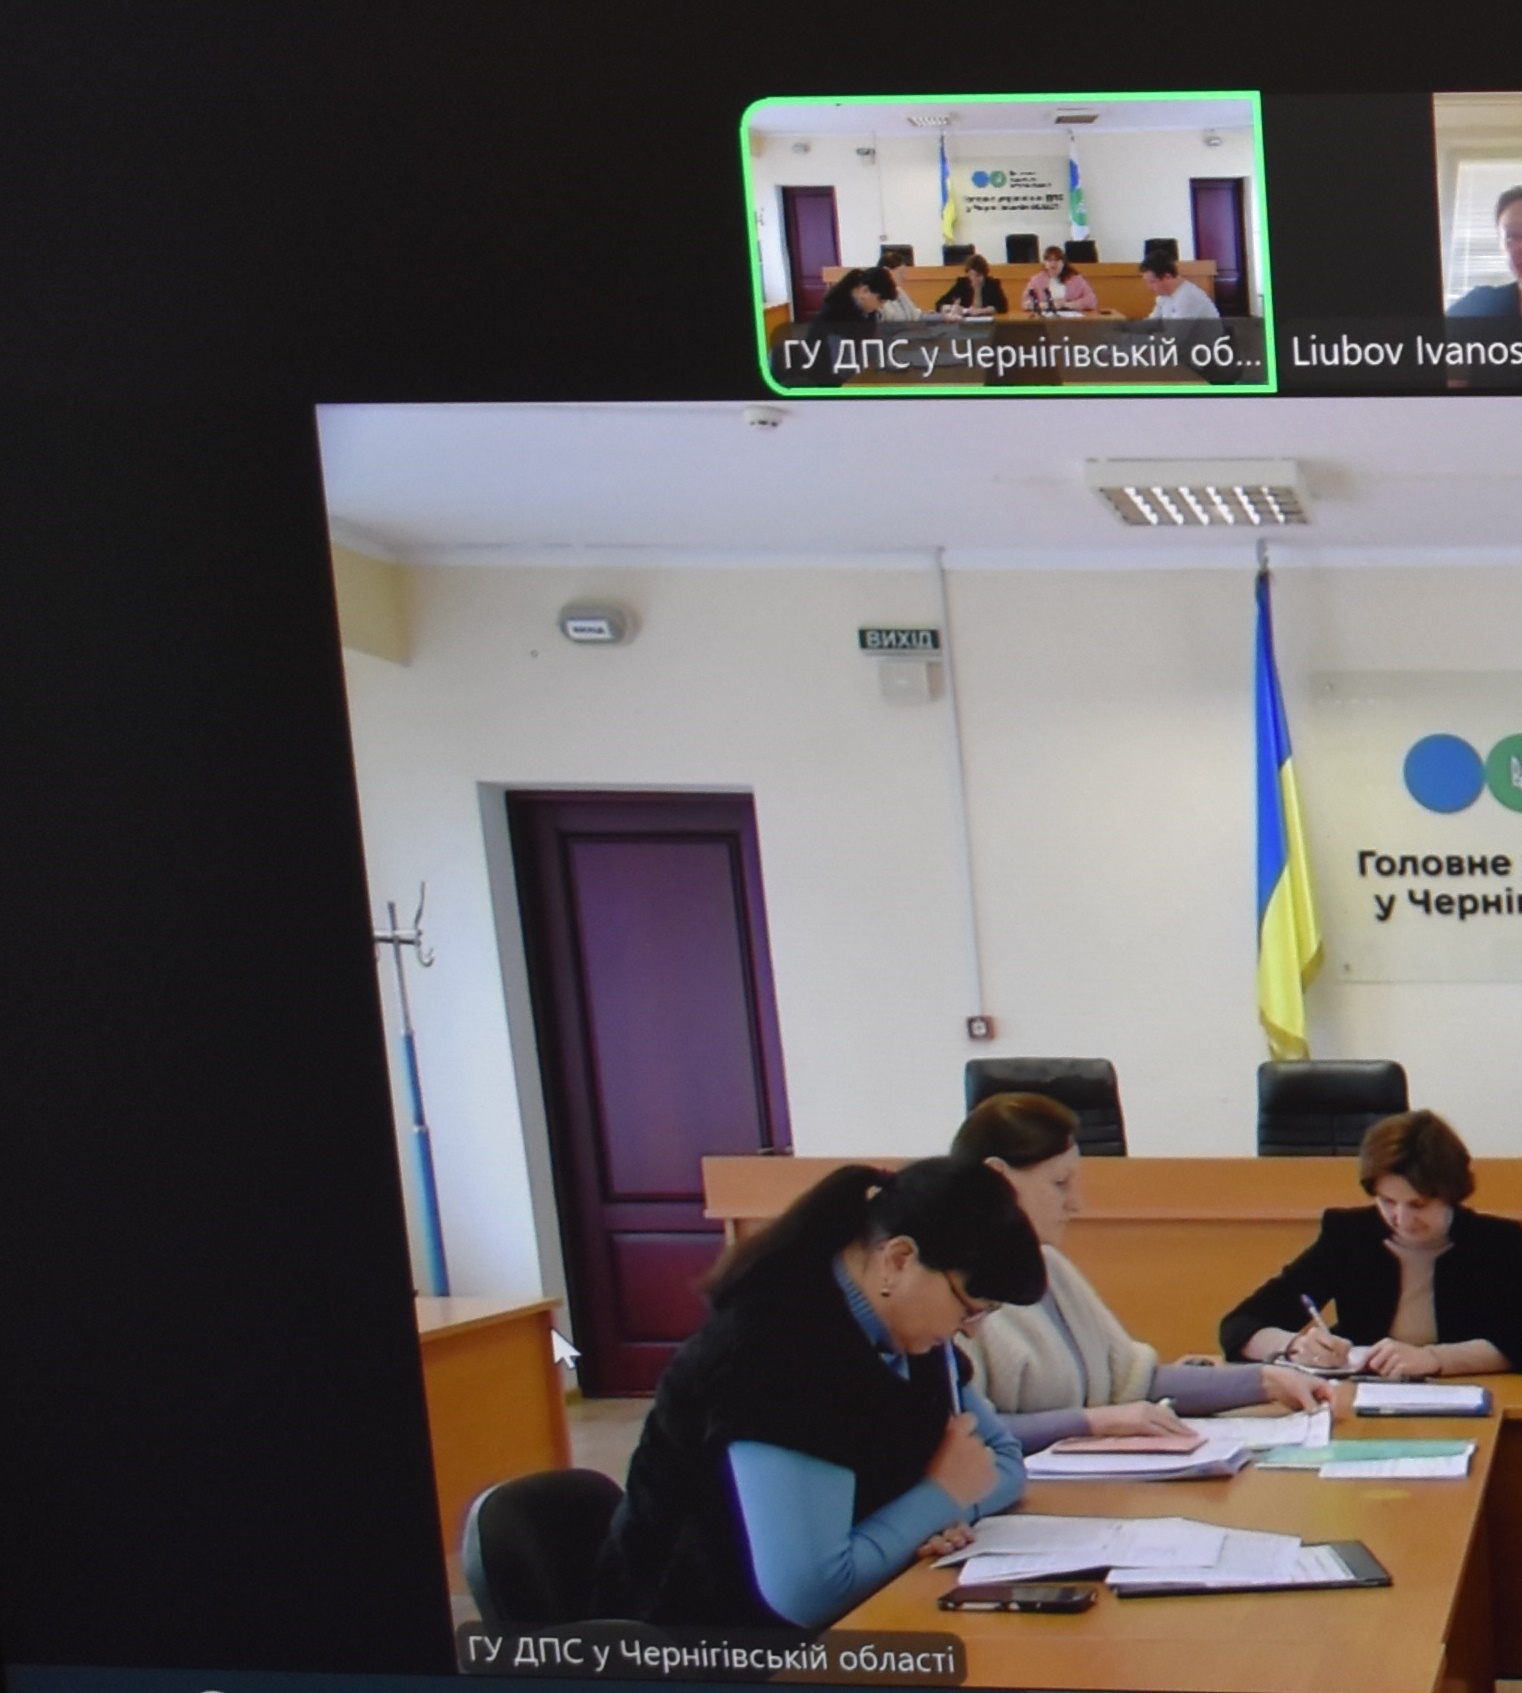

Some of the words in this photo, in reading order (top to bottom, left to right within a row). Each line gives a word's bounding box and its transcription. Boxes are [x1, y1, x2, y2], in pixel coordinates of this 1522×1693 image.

[783, 338, 822, 369] ГУ
[833, 339, 910, 372] ДПС
[921, 347, 939, 376] у
[950, 337, 1178, 377] Чернігівській
[1293, 333, 1404, 366] Liubov
[1357, 850, 1512, 879] Головне
[1374, 893, 1397, 922] у
[468, 1635, 504, 1663] ГУ
[513, 1636, 584, 1668] ДПС
[593, 1645, 610, 1672] у
[619, 1637, 829, 1675] Чернігівській
[838, 1643, 956, 1673] області
